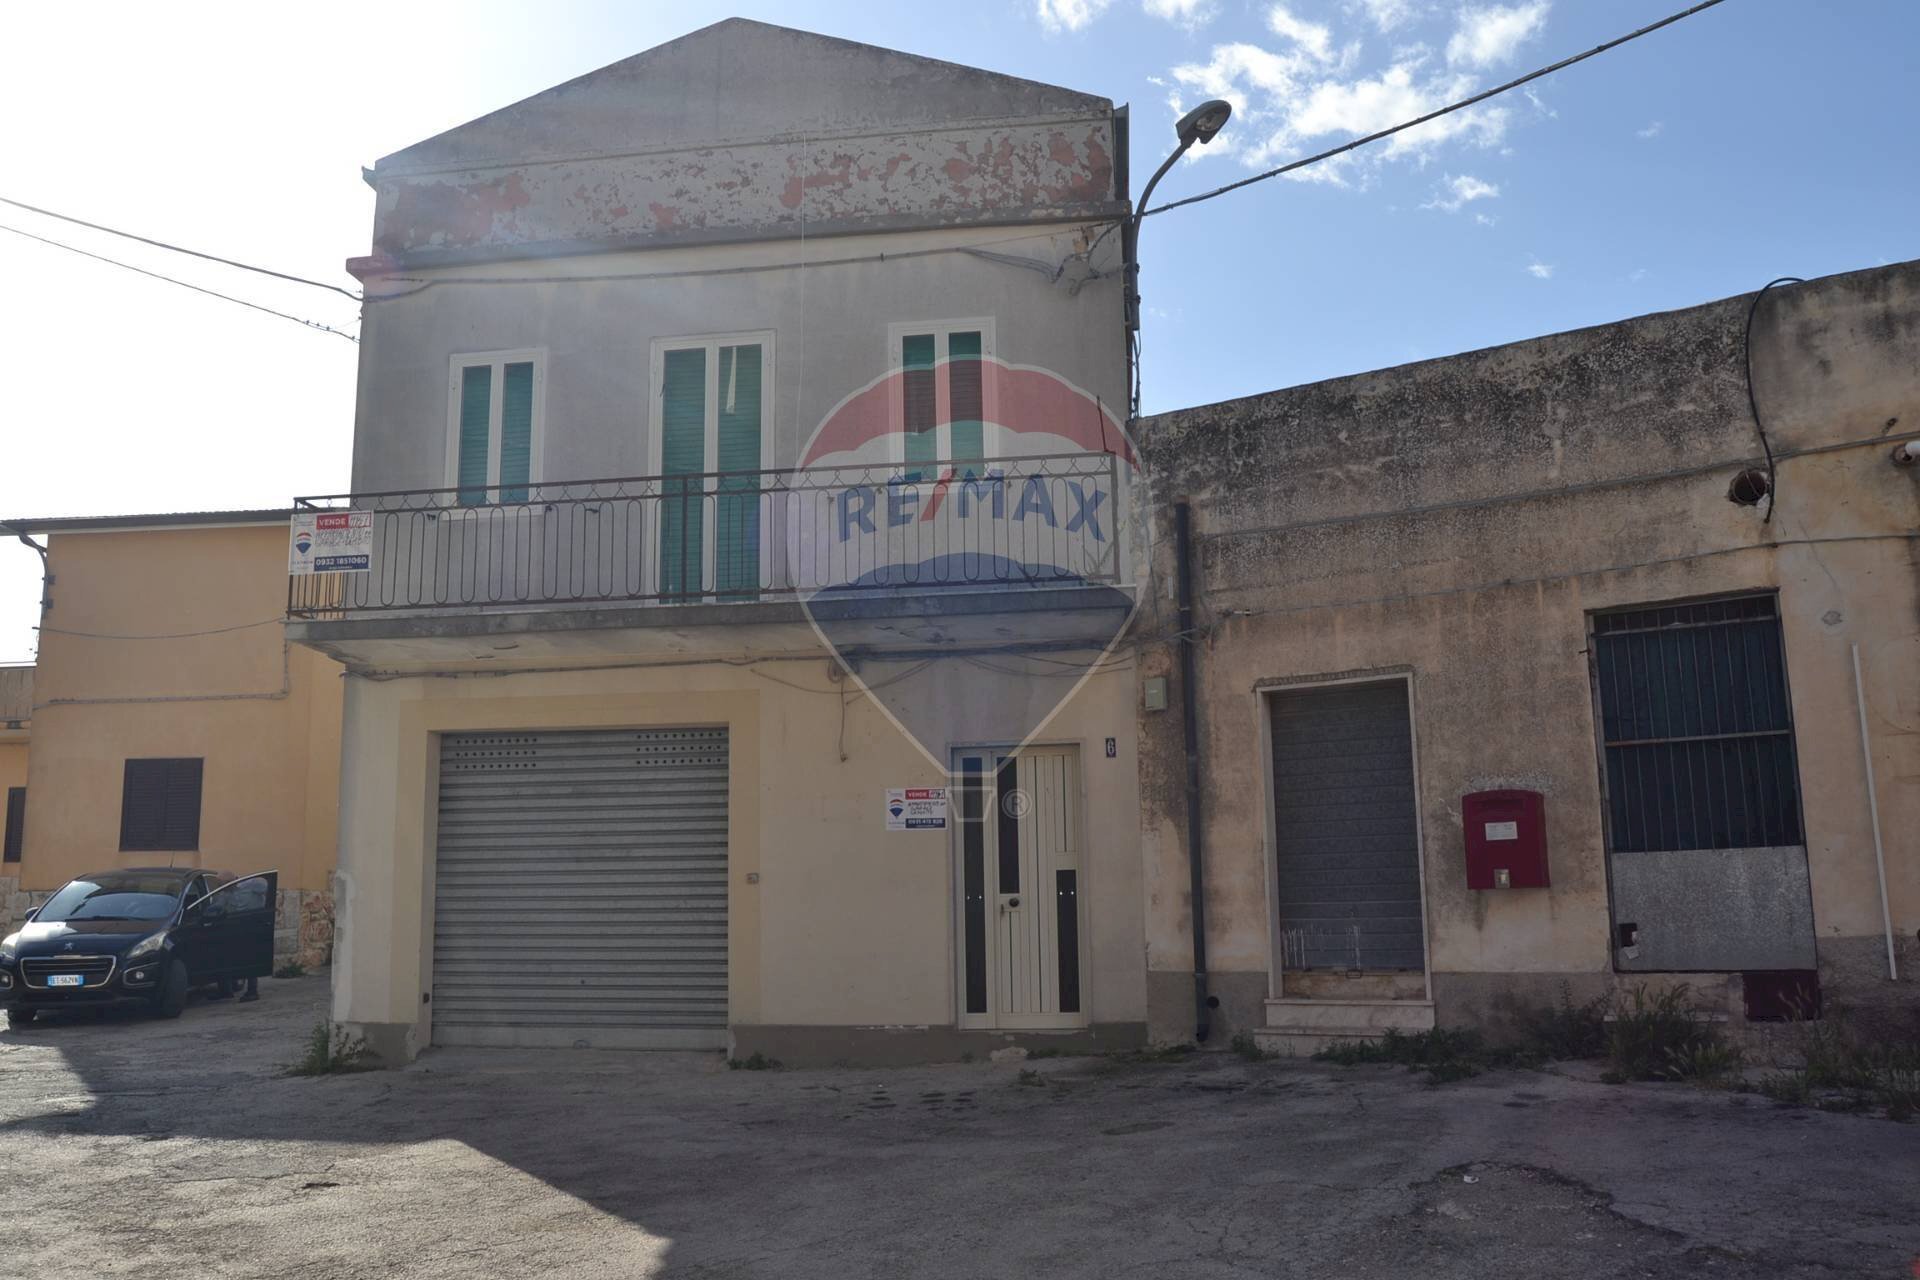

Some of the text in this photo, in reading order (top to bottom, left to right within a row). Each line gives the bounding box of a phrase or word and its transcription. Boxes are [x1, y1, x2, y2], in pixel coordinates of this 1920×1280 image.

[319, 518, 346, 526] VENDE
[315, 558, 334, 566] 0932
[336, 556, 367, 565] 1851060
[1107, 740, 1115, 756] 6
